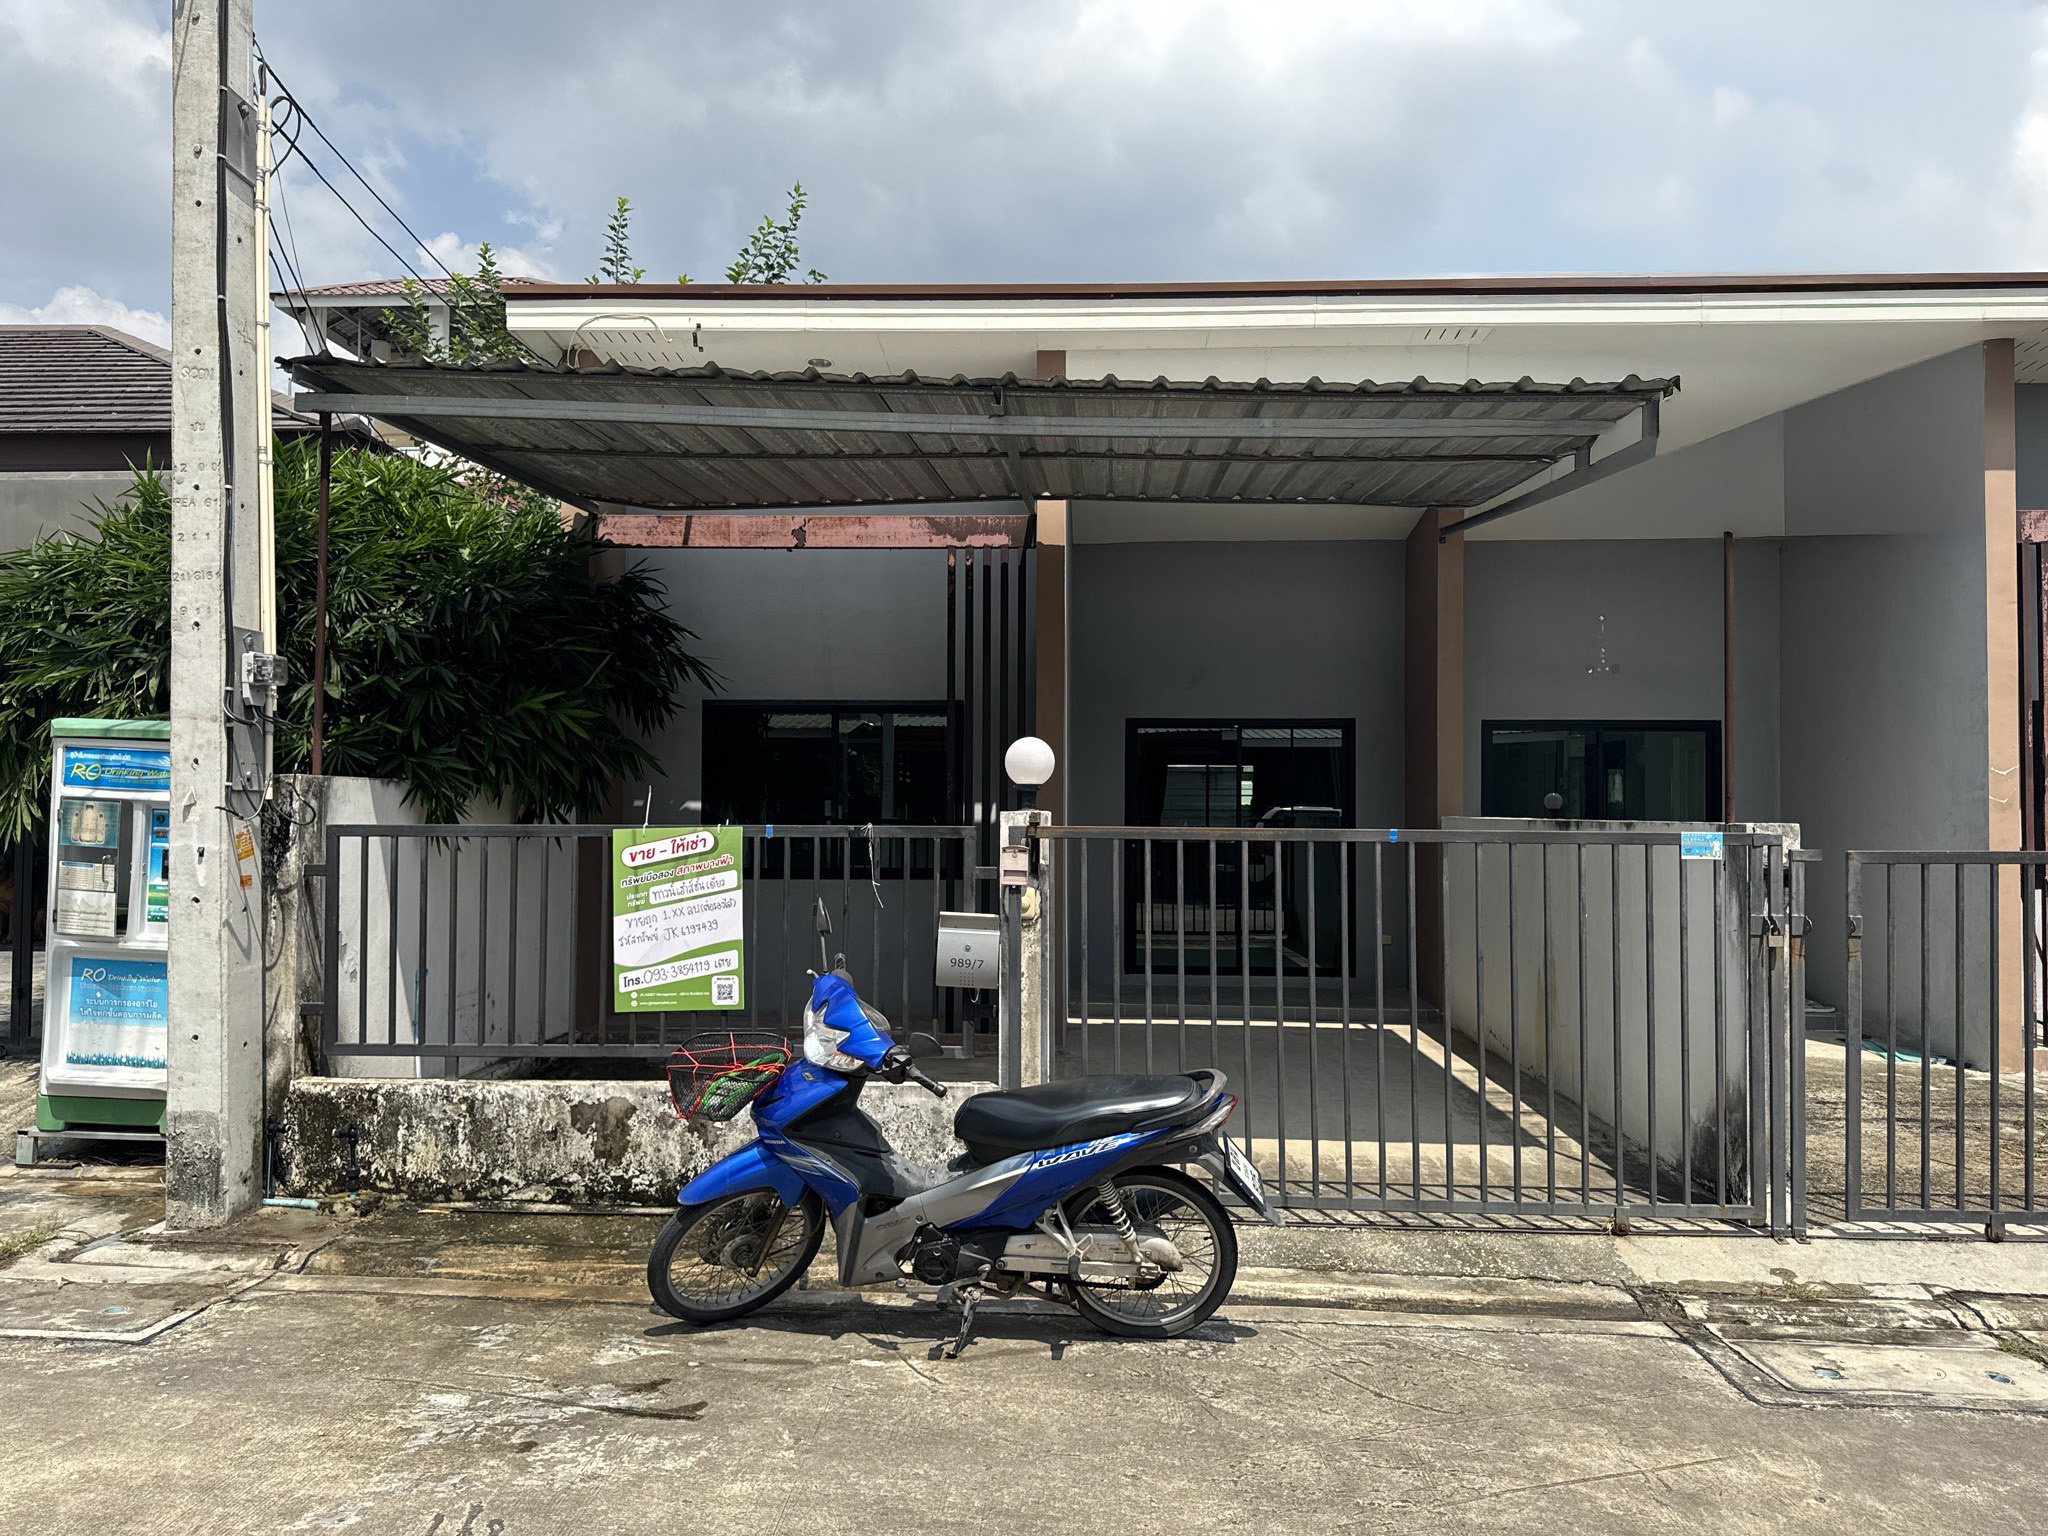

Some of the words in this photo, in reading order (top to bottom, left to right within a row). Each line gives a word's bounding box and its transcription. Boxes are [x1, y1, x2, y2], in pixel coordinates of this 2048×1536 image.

[70, 762, 103, 781] RO
[105, 768, 144, 779] Drinking
[629, 847, 656, 862] ขาย
[671, 834, 707, 854] ให้เช่า
[621, 869, 674, 887] ทรัพย์มือสอง
[676, 854, 733, 875] สภาพนางฟ้า
[950, 957, 985, 970] 989/7
[81, 967, 107, 982] RO
[86, 998, 158, 1008] ระบบการกรองอาร์โอ
[1038, 1142, 1119, 1169] WAVE
